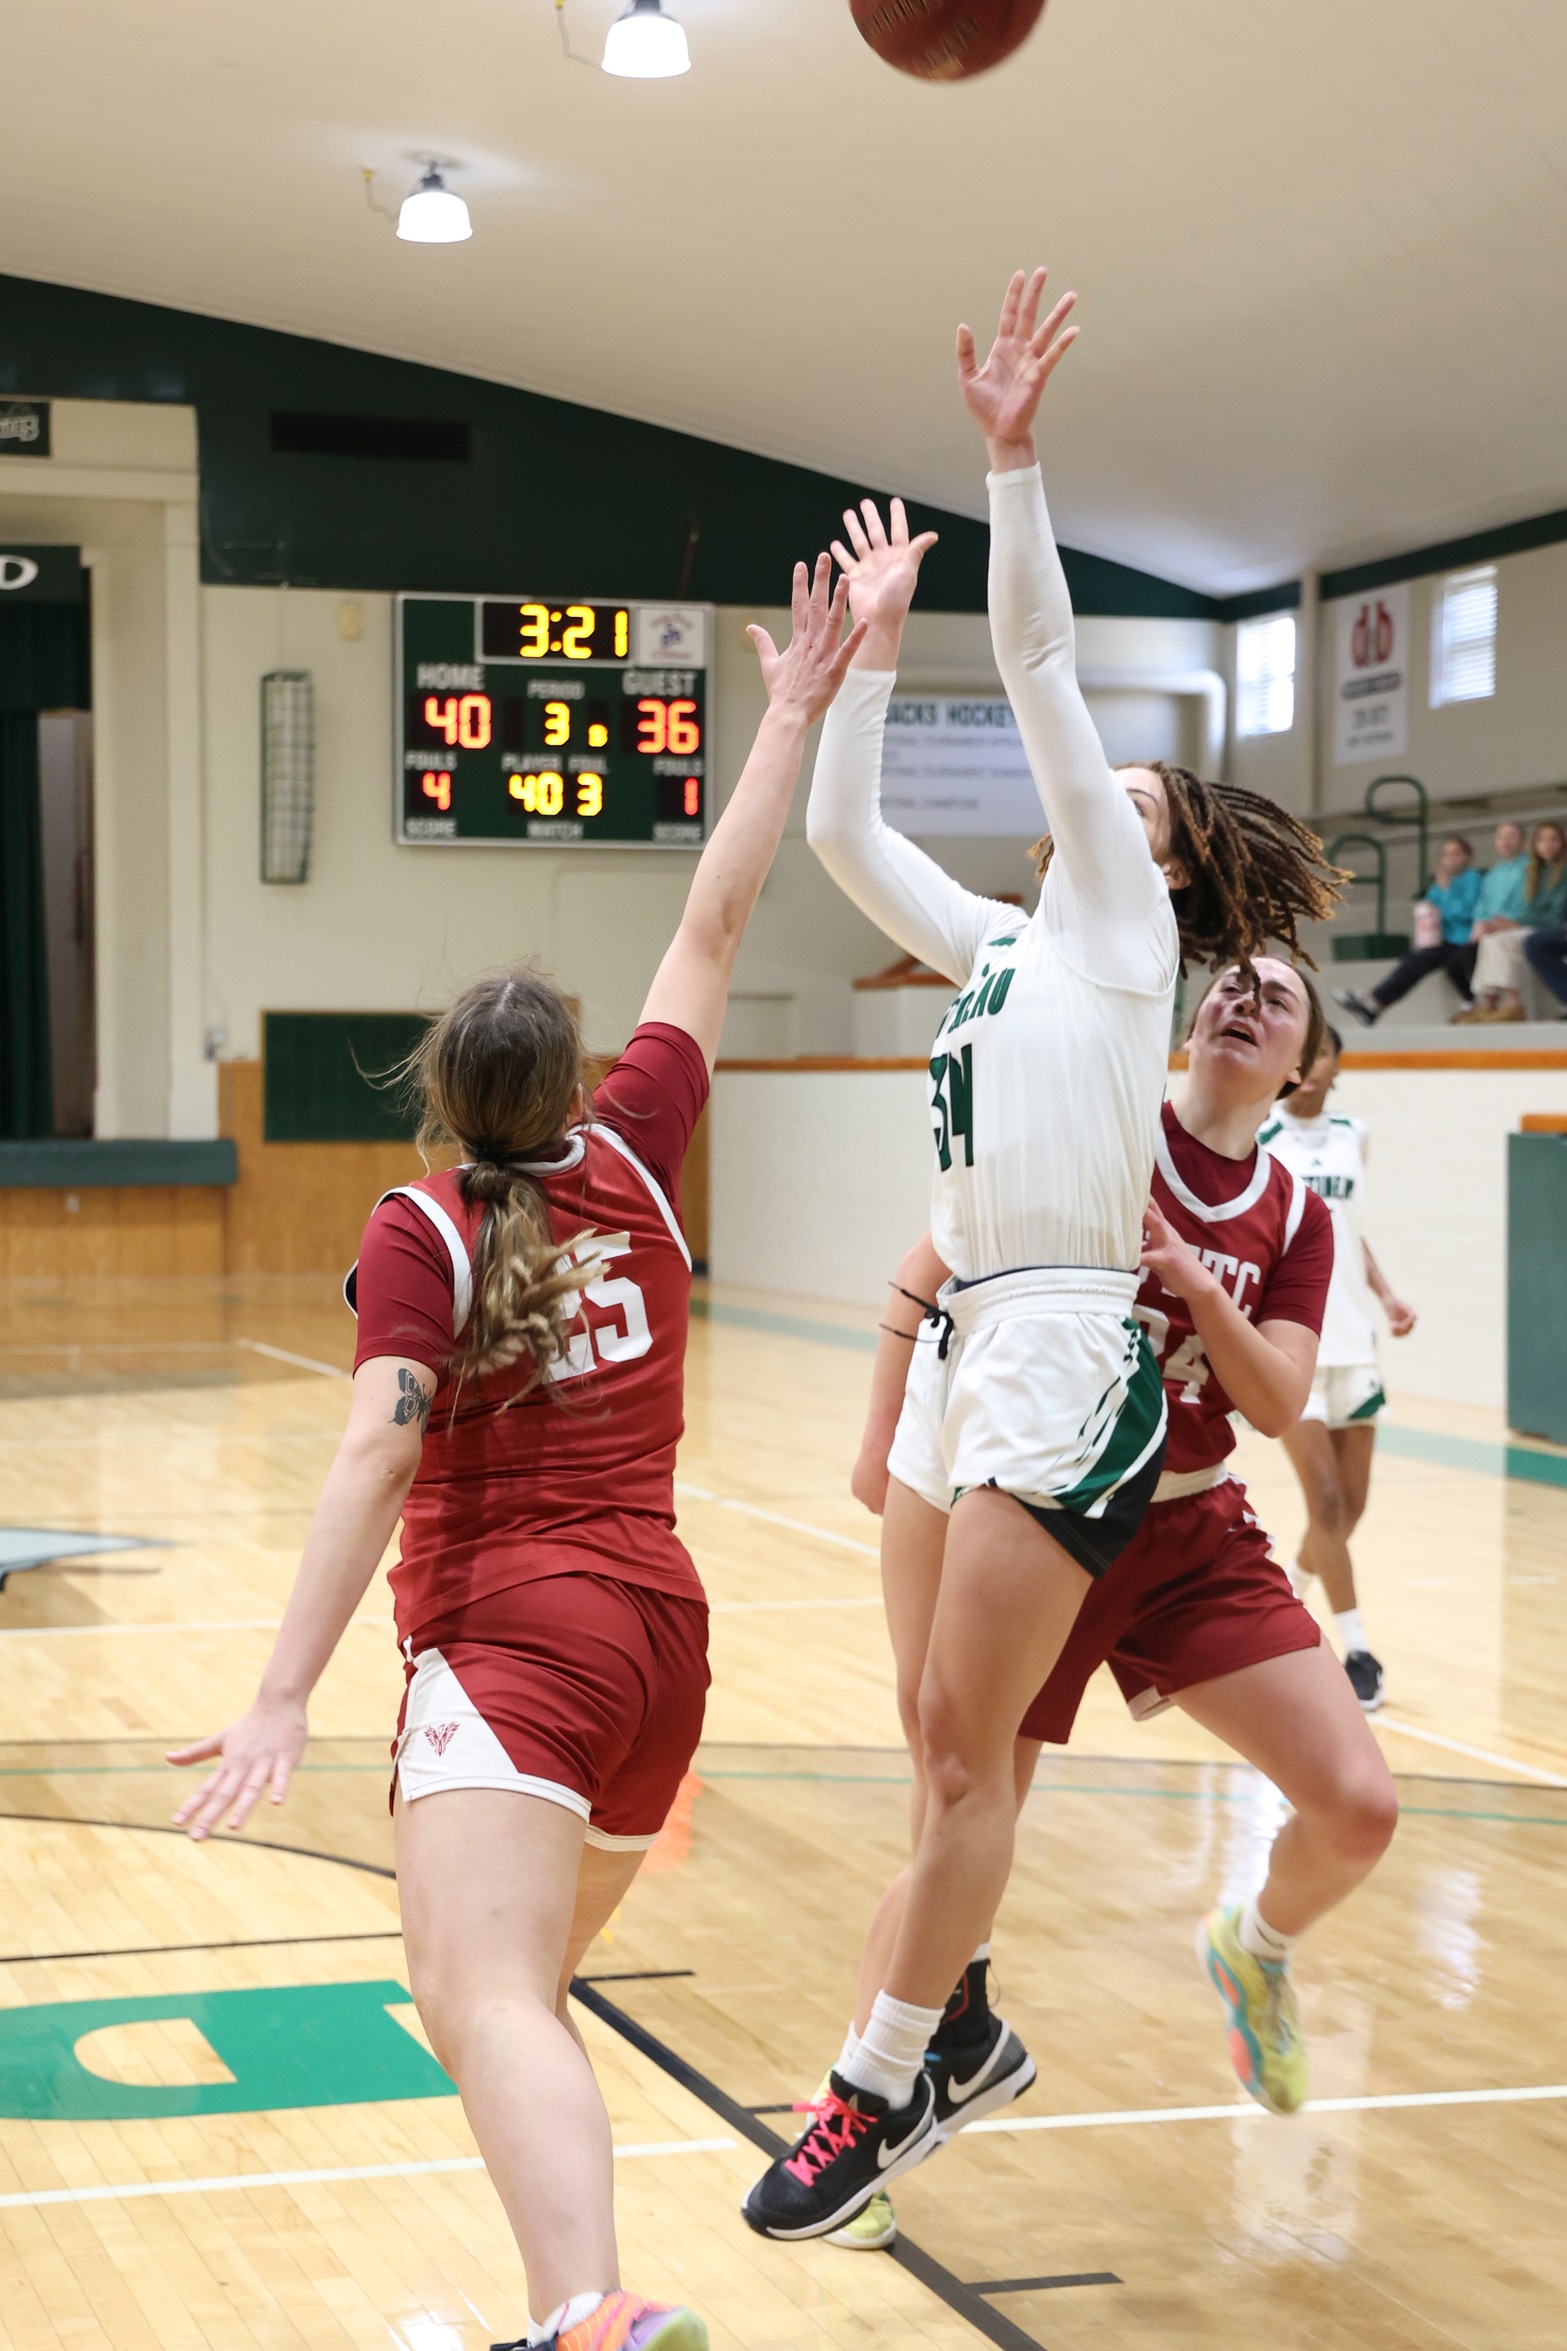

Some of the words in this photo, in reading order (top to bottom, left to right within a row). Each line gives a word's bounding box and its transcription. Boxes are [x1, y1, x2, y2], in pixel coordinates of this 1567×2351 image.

[520, 603, 629, 660] 3:21
[417, 664, 485, 690] HOME
[622, 671, 697, 695] GUEST
[425, 693, 491, 749] 40
[544, 702, 570, 746] 3
[637, 699, 700, 754] 36
[422, 770, 451, 811] 4
[509, 772, 564, 815] 40
[577, 772, 603, 816] 3
[684, 776, 699, 816] 1
